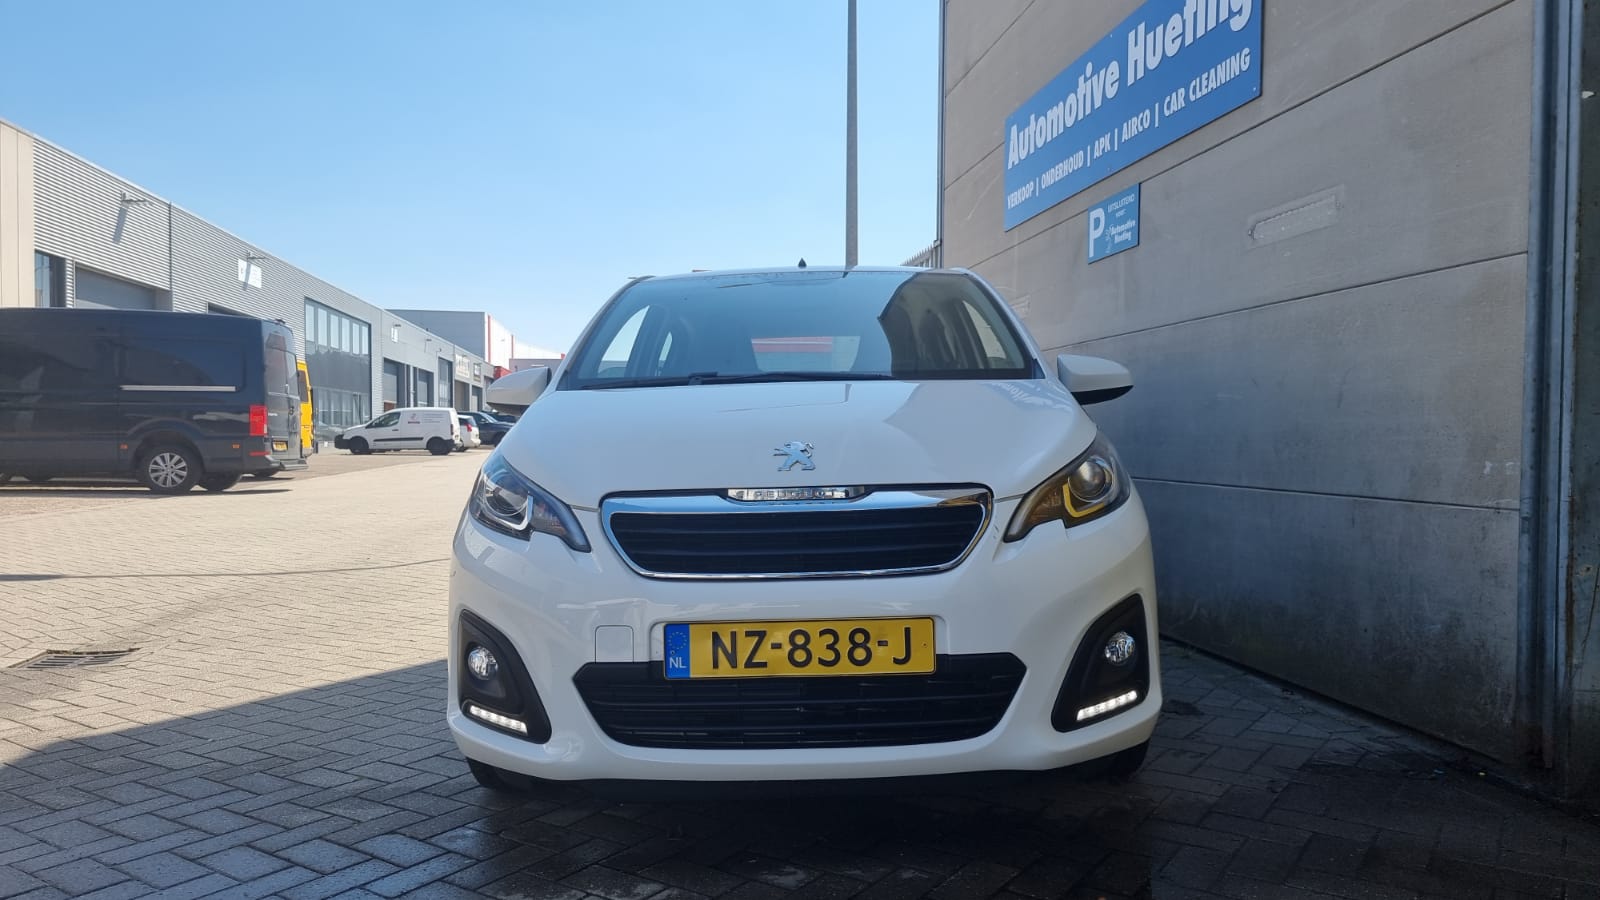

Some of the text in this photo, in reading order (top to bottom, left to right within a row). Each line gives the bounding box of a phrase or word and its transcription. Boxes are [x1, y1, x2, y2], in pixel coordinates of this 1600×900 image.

[1007, 181, 1034, 209] VERKOOP
[1041, 150, 1084, 189] ONDERHOUD
[1093, 132, 1111, 159] APK
[1121, 109, 1150, 142] AIRCO
[1163, 87, 1186, 117] CAR
[1189, 47, 1251, 102] CLEANING
[1008, 61, 1120, 170] Automotive
[1088, 207, 1105, 258] P
[669, 656, 687, 669] NL
[711, 626, 912, 670] NZ-838-J
